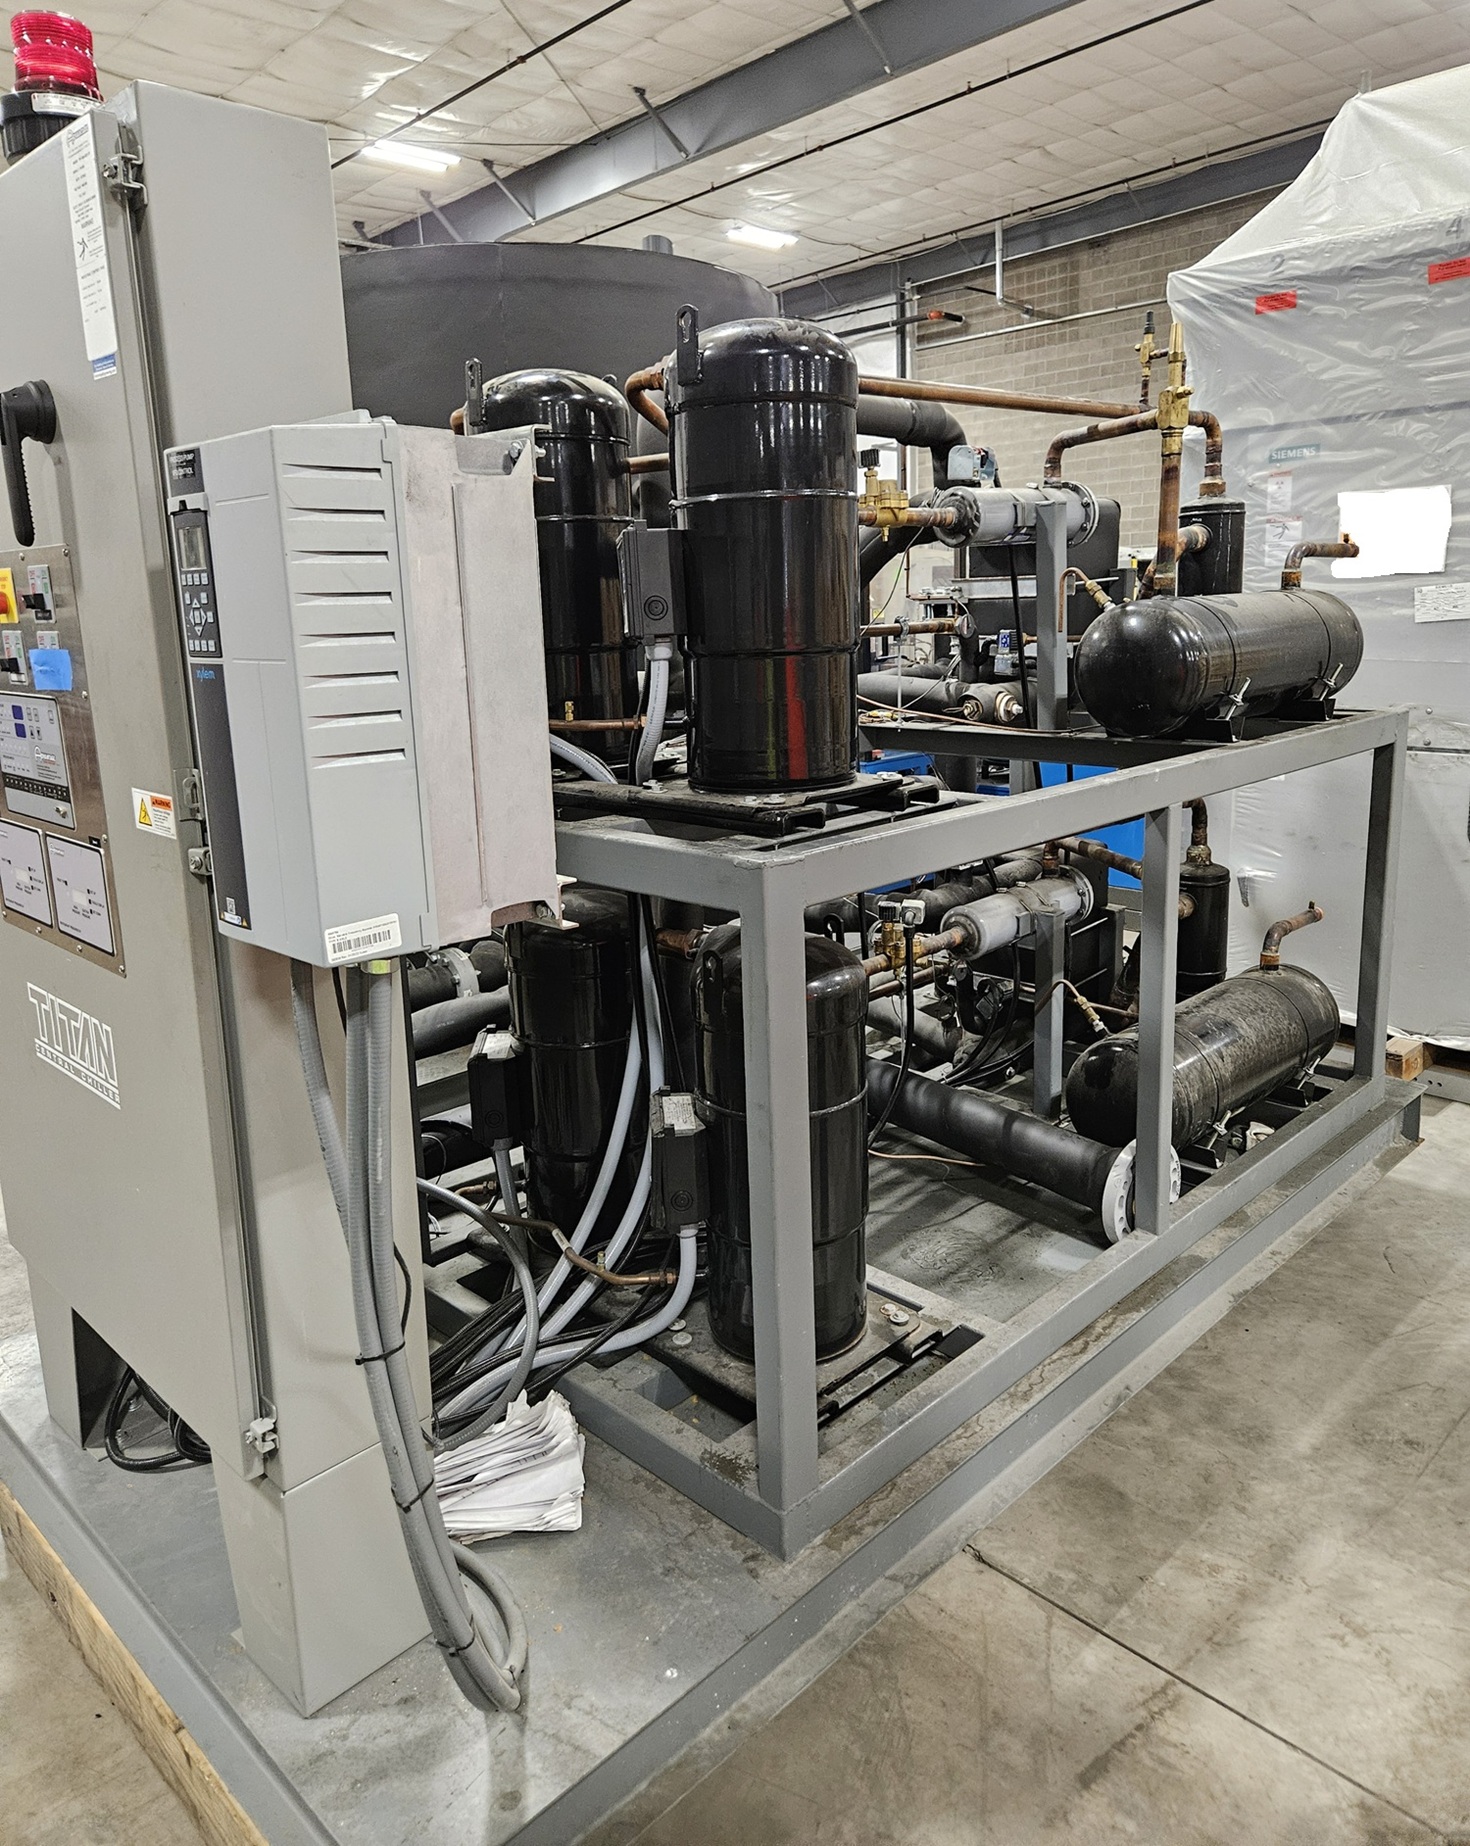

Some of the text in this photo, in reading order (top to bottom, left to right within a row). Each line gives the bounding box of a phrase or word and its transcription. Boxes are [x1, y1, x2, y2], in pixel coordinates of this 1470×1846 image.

[1445, 216, 1464, 239] 4
[1271, 254, 1285, 277] 2
[1271, 447, 1316, 460] SIEMENS
[196, 666, 216, 682] xylem
[27, 981, 119, 1088] TITAN
[35, 1043, 121, 1104] CENTRAL CHILLER
